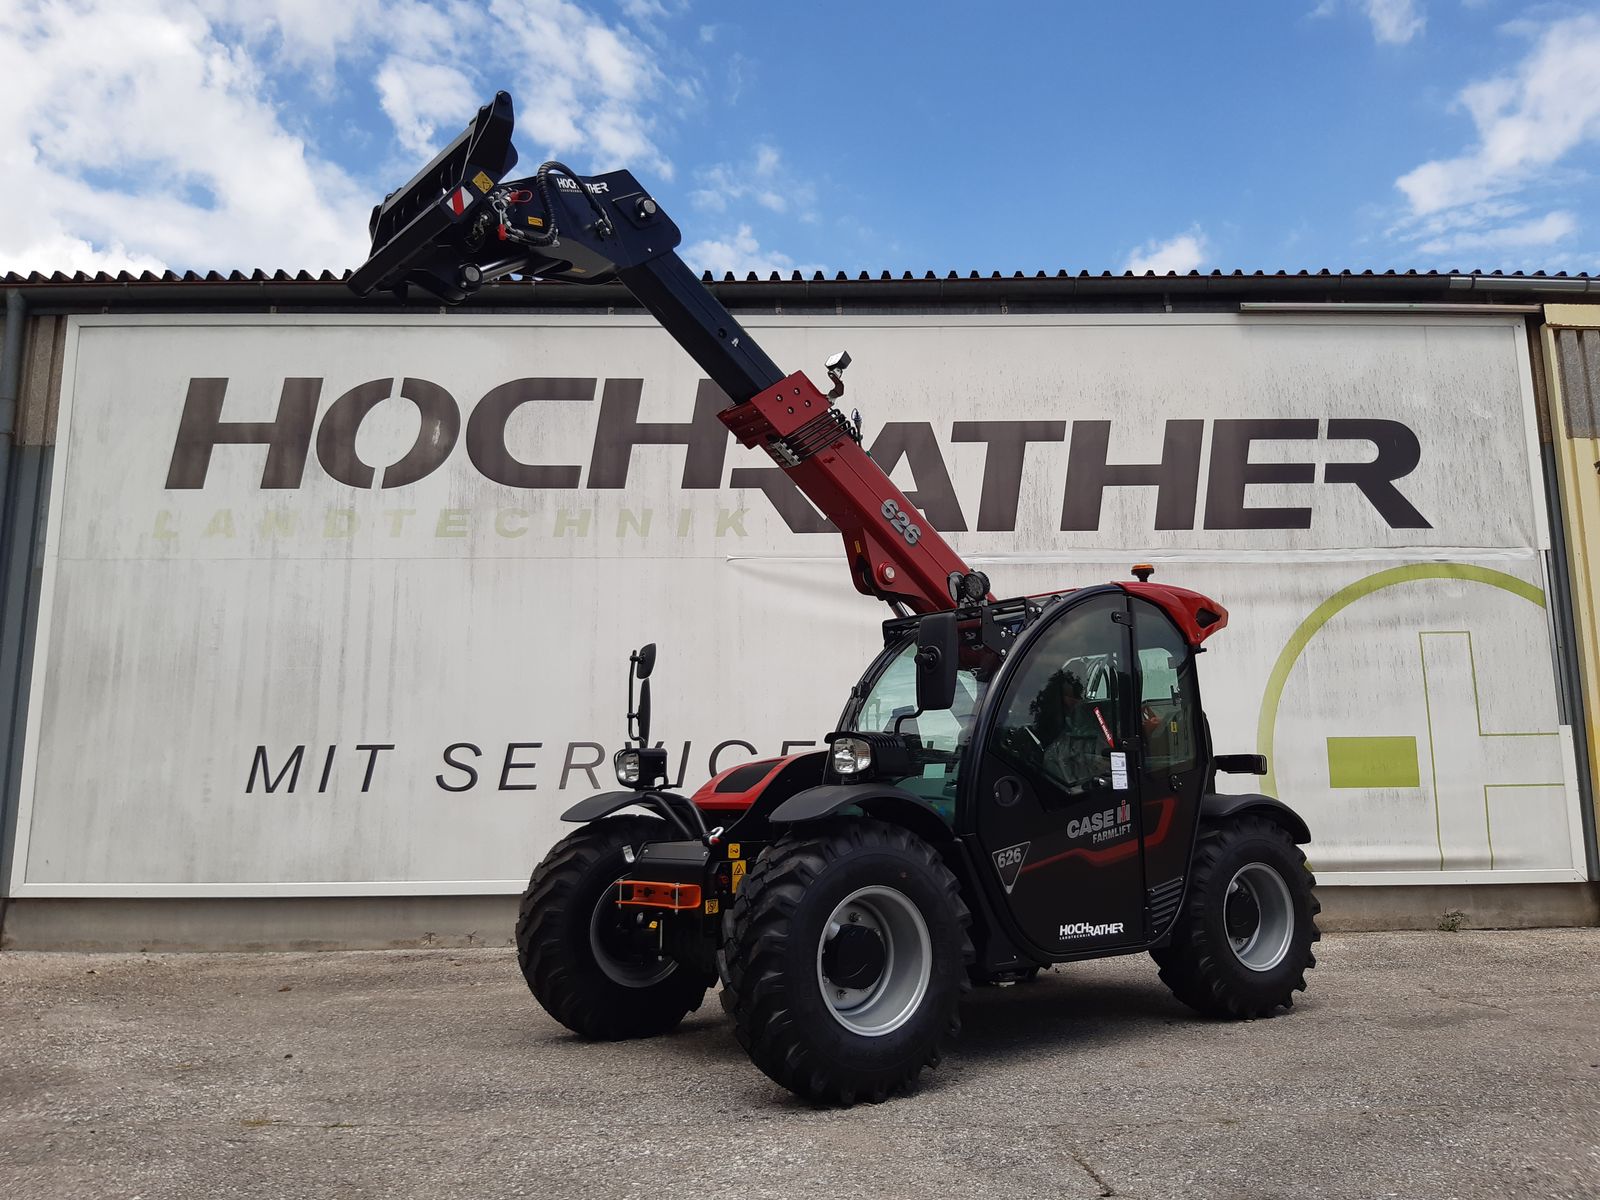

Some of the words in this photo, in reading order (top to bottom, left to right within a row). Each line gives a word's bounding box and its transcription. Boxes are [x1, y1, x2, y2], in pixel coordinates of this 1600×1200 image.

[556, 177, 610, 194] HOCHTHER
[152, 507, 751, 538] LANDTECHNIK
[880, 499, 922, 545] 626
[246, 744, 395, 793] MIT
[436, 740, 817, 791] SERIC
[1066, 808, 1114, 839] CASE
[1092, 824, 1132, 844] FARMLIFT
[997, 847, 1022, 868] 626
[1059, 922, 1124, 936] HOCHRATHER
